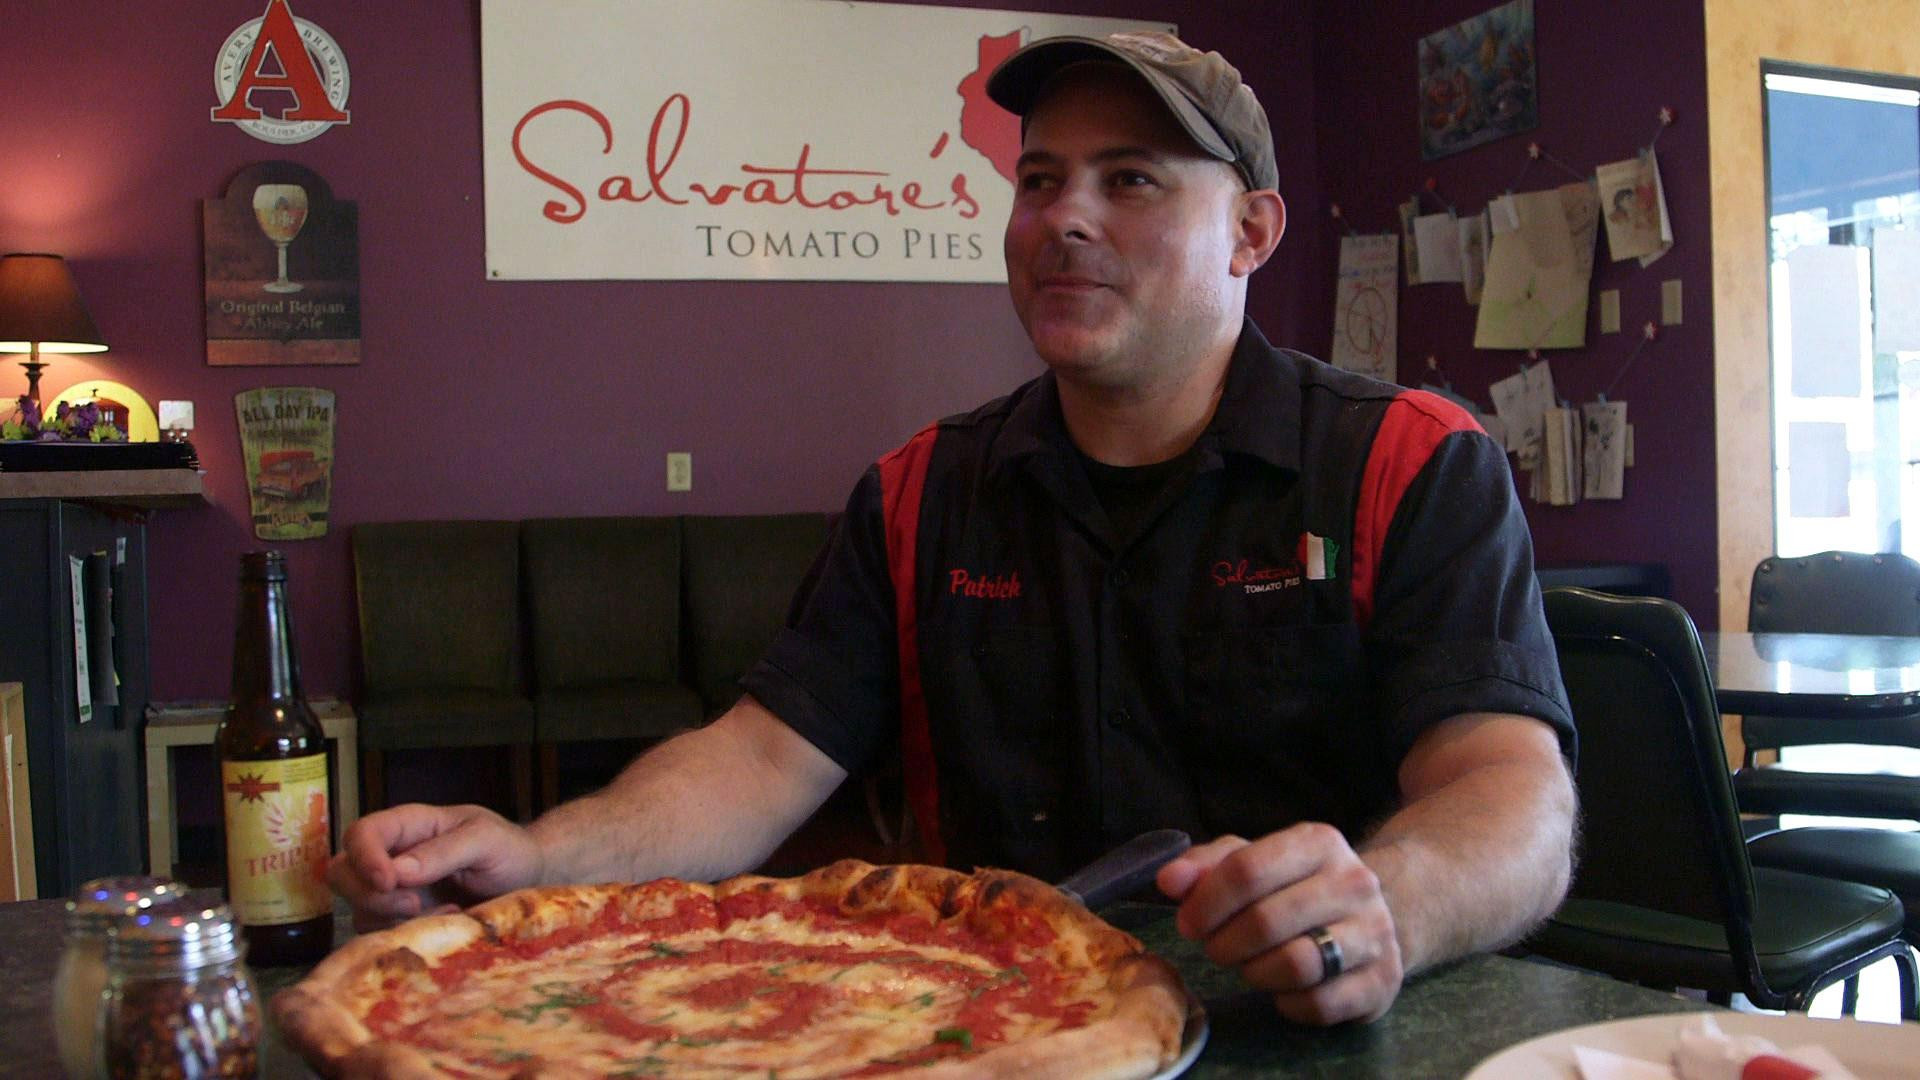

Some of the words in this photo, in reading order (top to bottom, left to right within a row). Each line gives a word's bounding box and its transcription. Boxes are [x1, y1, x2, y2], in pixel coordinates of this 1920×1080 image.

[223, 31, 253, 81] AVERY
[303, 29, 342, 101] BREWING
[511, 93, 981, 224] Salvatore's
[696, 226, 880, 259] TOMATO
[903, 228, 984, 261] PIES
[220, 300, 284, 317] Original
[289, 300, 345, 318] Belgian
[242, 408, 270, 423] ALL
[274, 404, 301, 420] DAY
[306, 404, 329, 421] IPA
[949, 567, 1021, 599] Patrick
[1244, 581, 1282, 594] TOMATO
[1285, 577, 1301, 589] PIES
